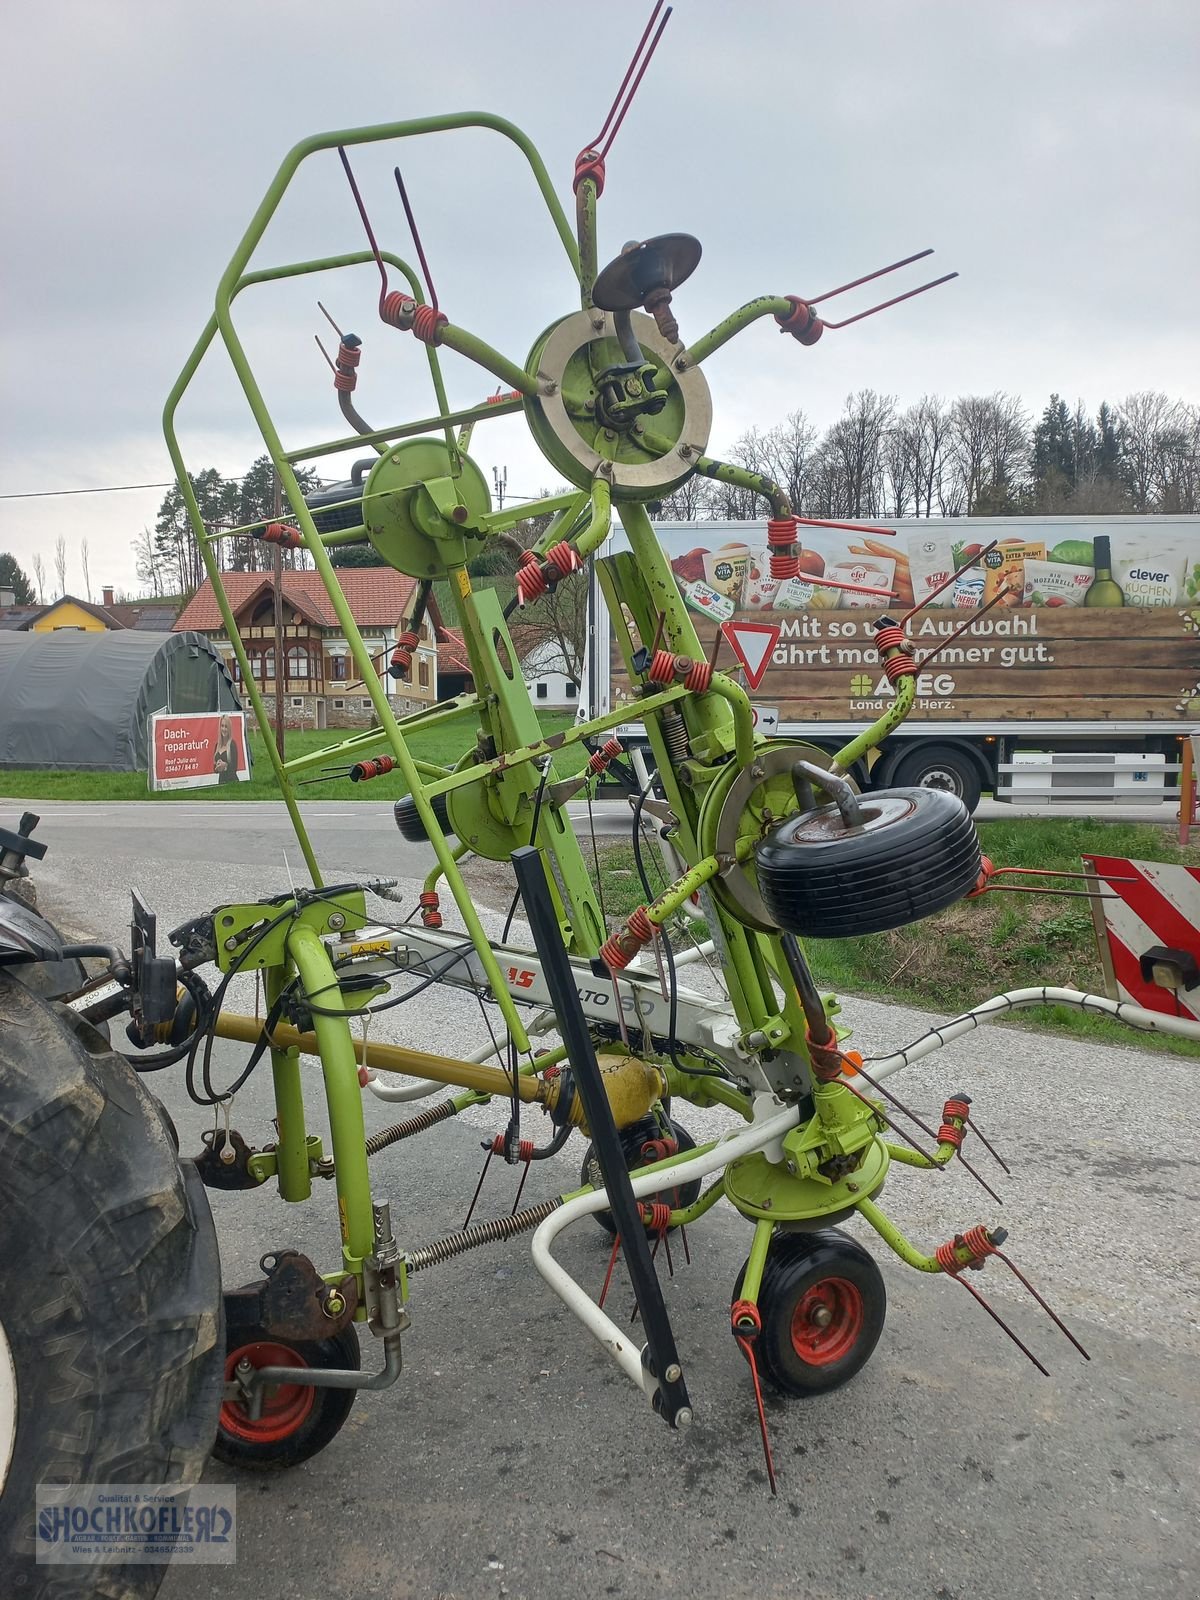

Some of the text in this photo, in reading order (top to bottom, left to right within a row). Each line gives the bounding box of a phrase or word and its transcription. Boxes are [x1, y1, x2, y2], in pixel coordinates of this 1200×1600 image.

[1129, 568, 1170, 582] clever
[1125, 581, 1172, 597] KÜCHEN
[780, 614, 1038, 637] Mit so vl Auswahl
[772, 642, 1055, 668] ährt ma mmer gut.
[874, 673, 956, 696] AEG
[850, 700, 883, 710] Land
[919, 699, 956, 710] Herz.
[164, 728, 190, 739] Dach-
[164, 739, 209, 754] reparatur?
[577, 988, 610, 1006] LTO
